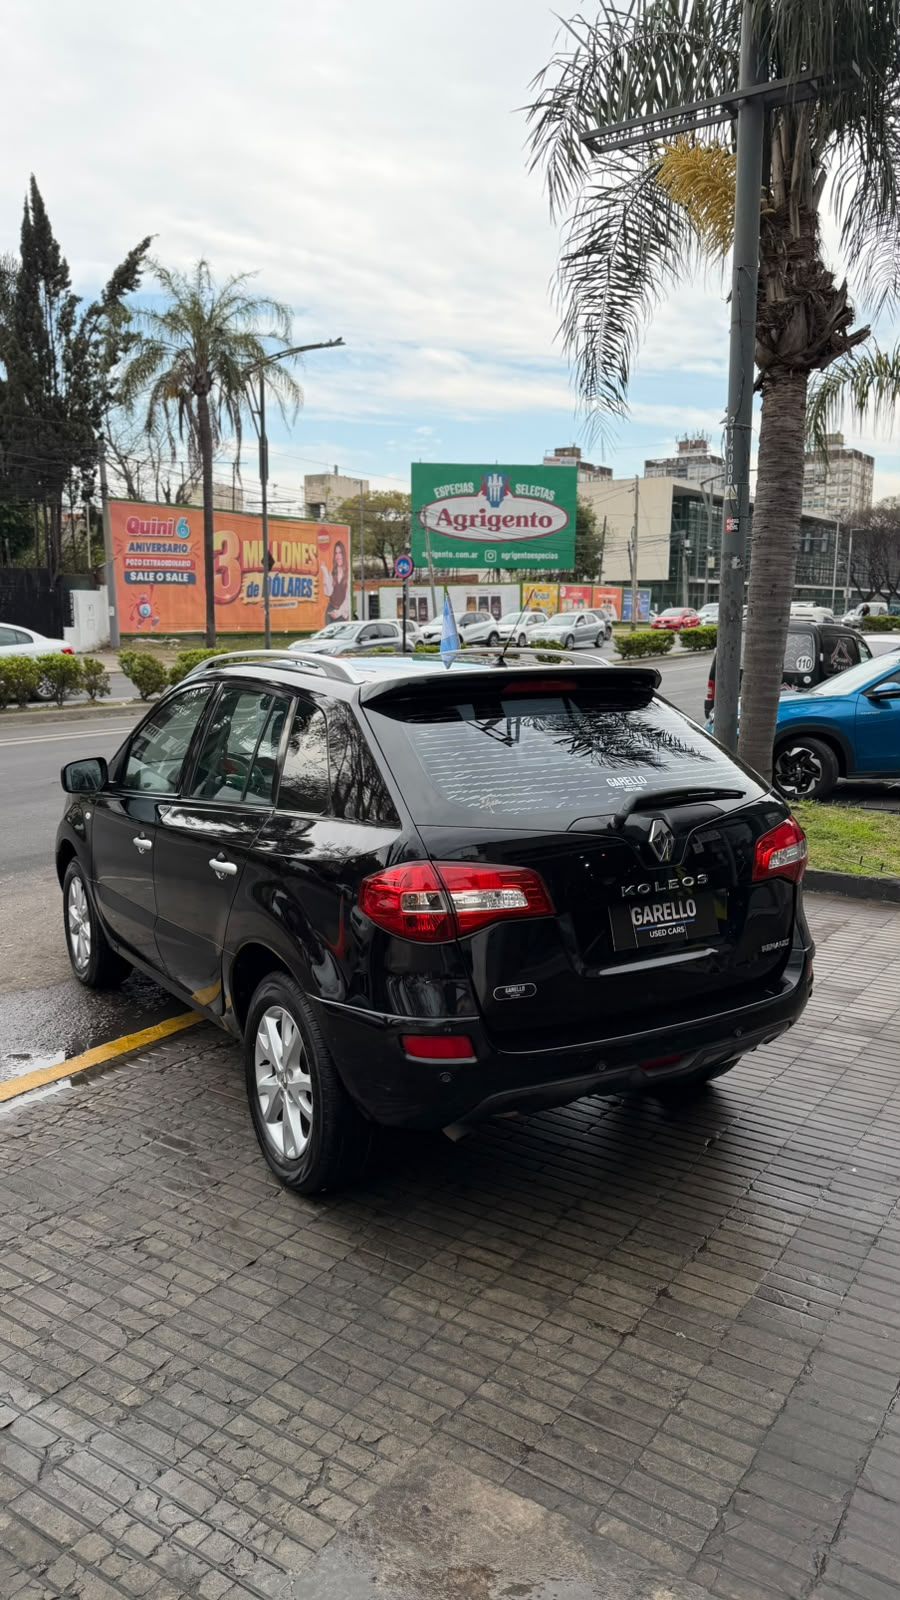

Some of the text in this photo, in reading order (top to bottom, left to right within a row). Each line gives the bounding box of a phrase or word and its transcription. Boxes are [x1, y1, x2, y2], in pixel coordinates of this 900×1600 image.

[433, 482, 556, 501] ESPECIAS SELECTAS
[126, 516, 191, 539] Quini 6
[436, 508, 553, 532] Agrigento
[128, 542, 189, 553] ANIVERSARIO
[243, 540, 317, 571] MILONES
[125, 558, 142, 566] POZO
[213, 530, 241, 601] 3
[130, 572, 189, 582] SALE O SALE
[246, 581, 259, 598] de
[798, 658, 811, 669] 110
[606, 775, 648, 787] GARELLO
[620, 873, 709, 898] KOLEOS
[631, 898, 697, 926] GARELLO
[649, 925, 685, 938] USED CARS
